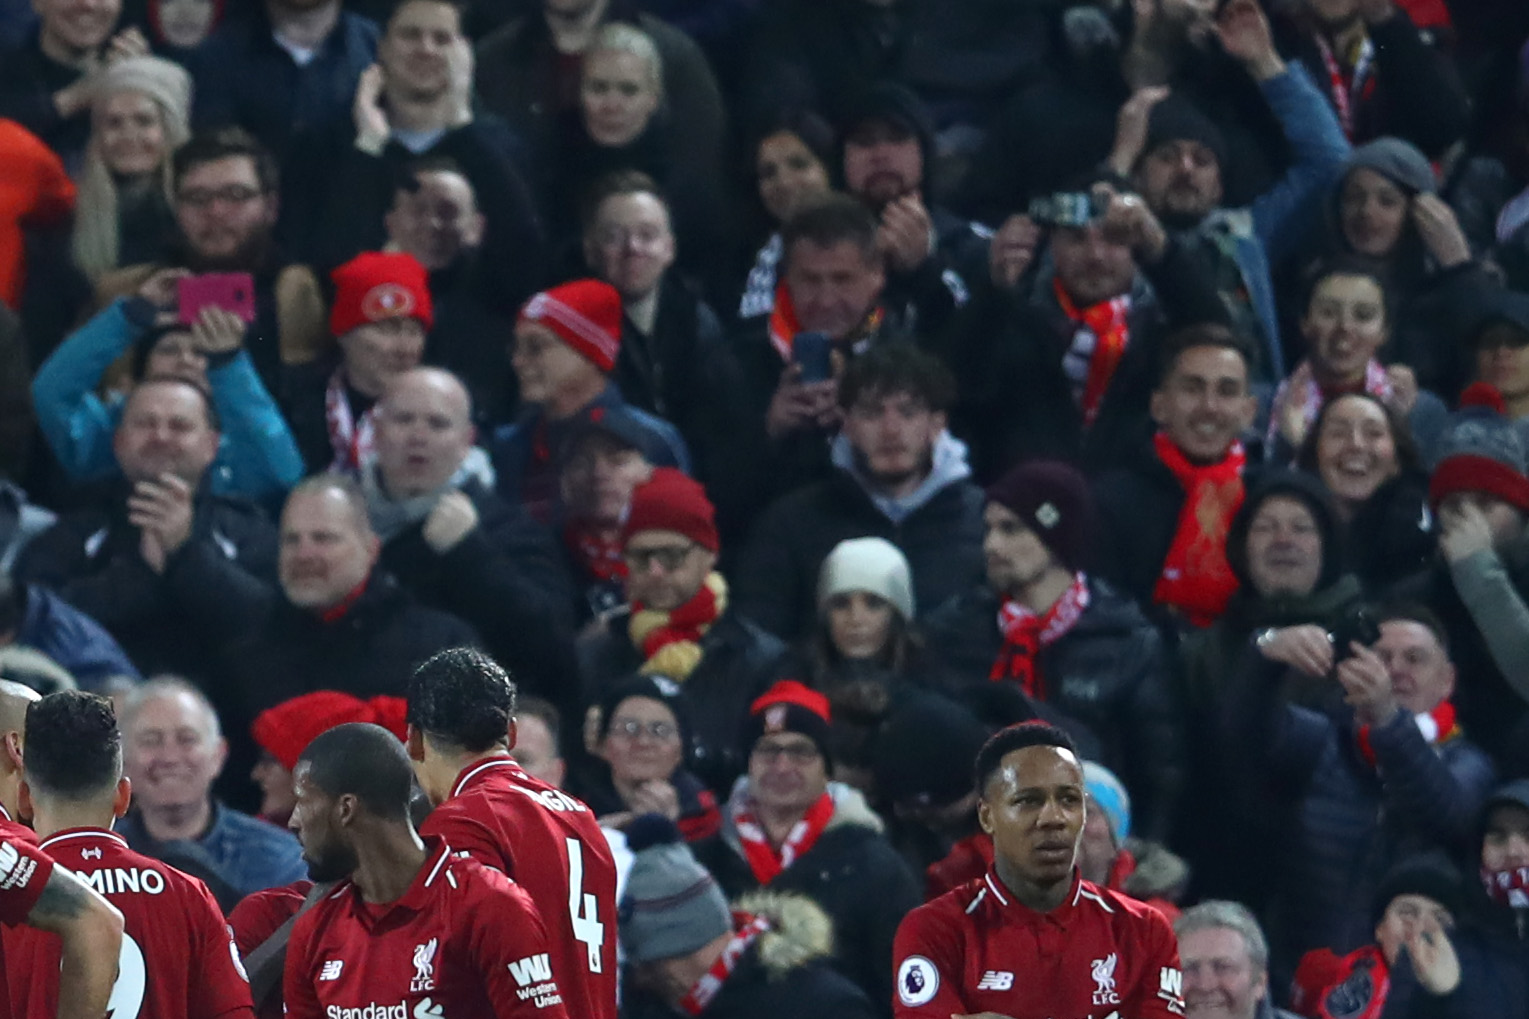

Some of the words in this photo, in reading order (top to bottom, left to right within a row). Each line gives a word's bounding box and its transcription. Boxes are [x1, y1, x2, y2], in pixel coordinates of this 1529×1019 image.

[0, 855, 30, 890] Western
[15, 859, 38, 888] Union
[565, 837, 604, 974] 4
[507, 952, 553, 987] WU
[534, 993, 563, 1009] Union
